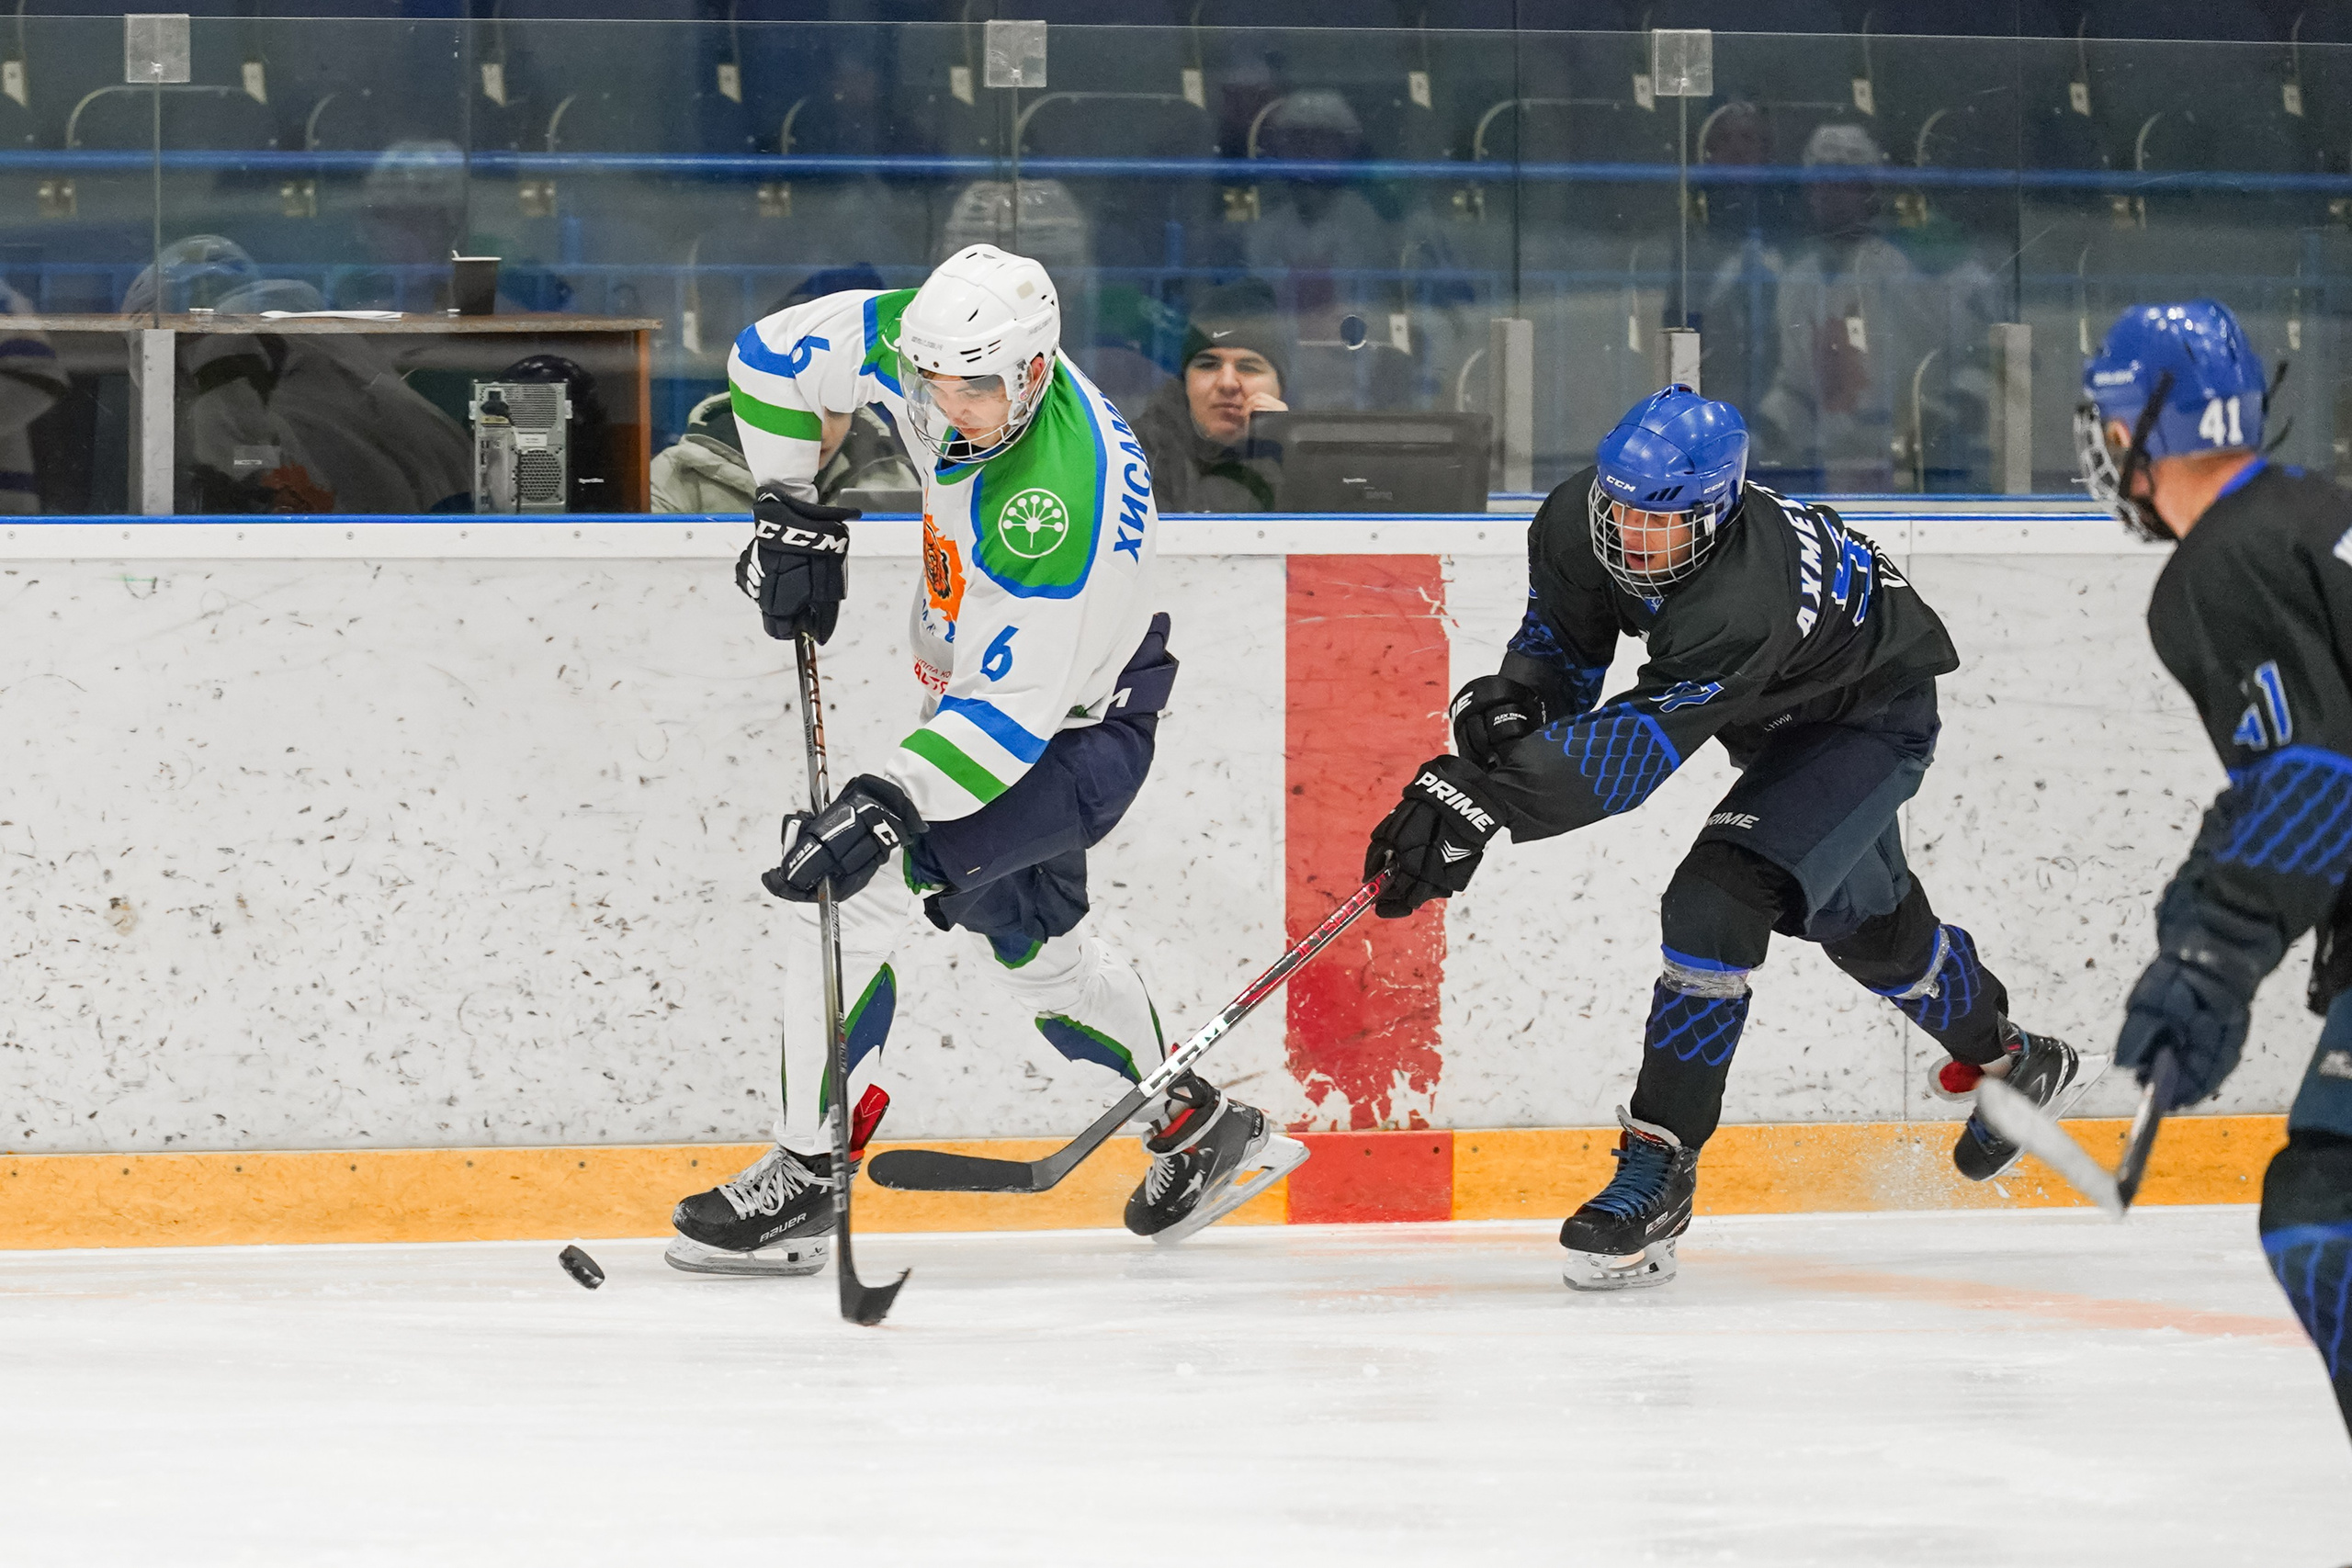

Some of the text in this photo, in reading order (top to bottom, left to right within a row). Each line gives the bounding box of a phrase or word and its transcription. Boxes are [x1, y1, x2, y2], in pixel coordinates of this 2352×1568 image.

[791, 335, 830, 374] 6
[2199, 395, 2244, 446] 41
[1605, 474, 1637, 493] CCM
[1702, 479, 1726, 495] CCM
[755, 518, 850, 554] CCM
[980, 625, 1020, 682] 6
[1415, 771, 1497, 834] PRIME
[1137, 1012, 1229, 1099] CCM
[759, 1212, 808, 1244] BAUER
